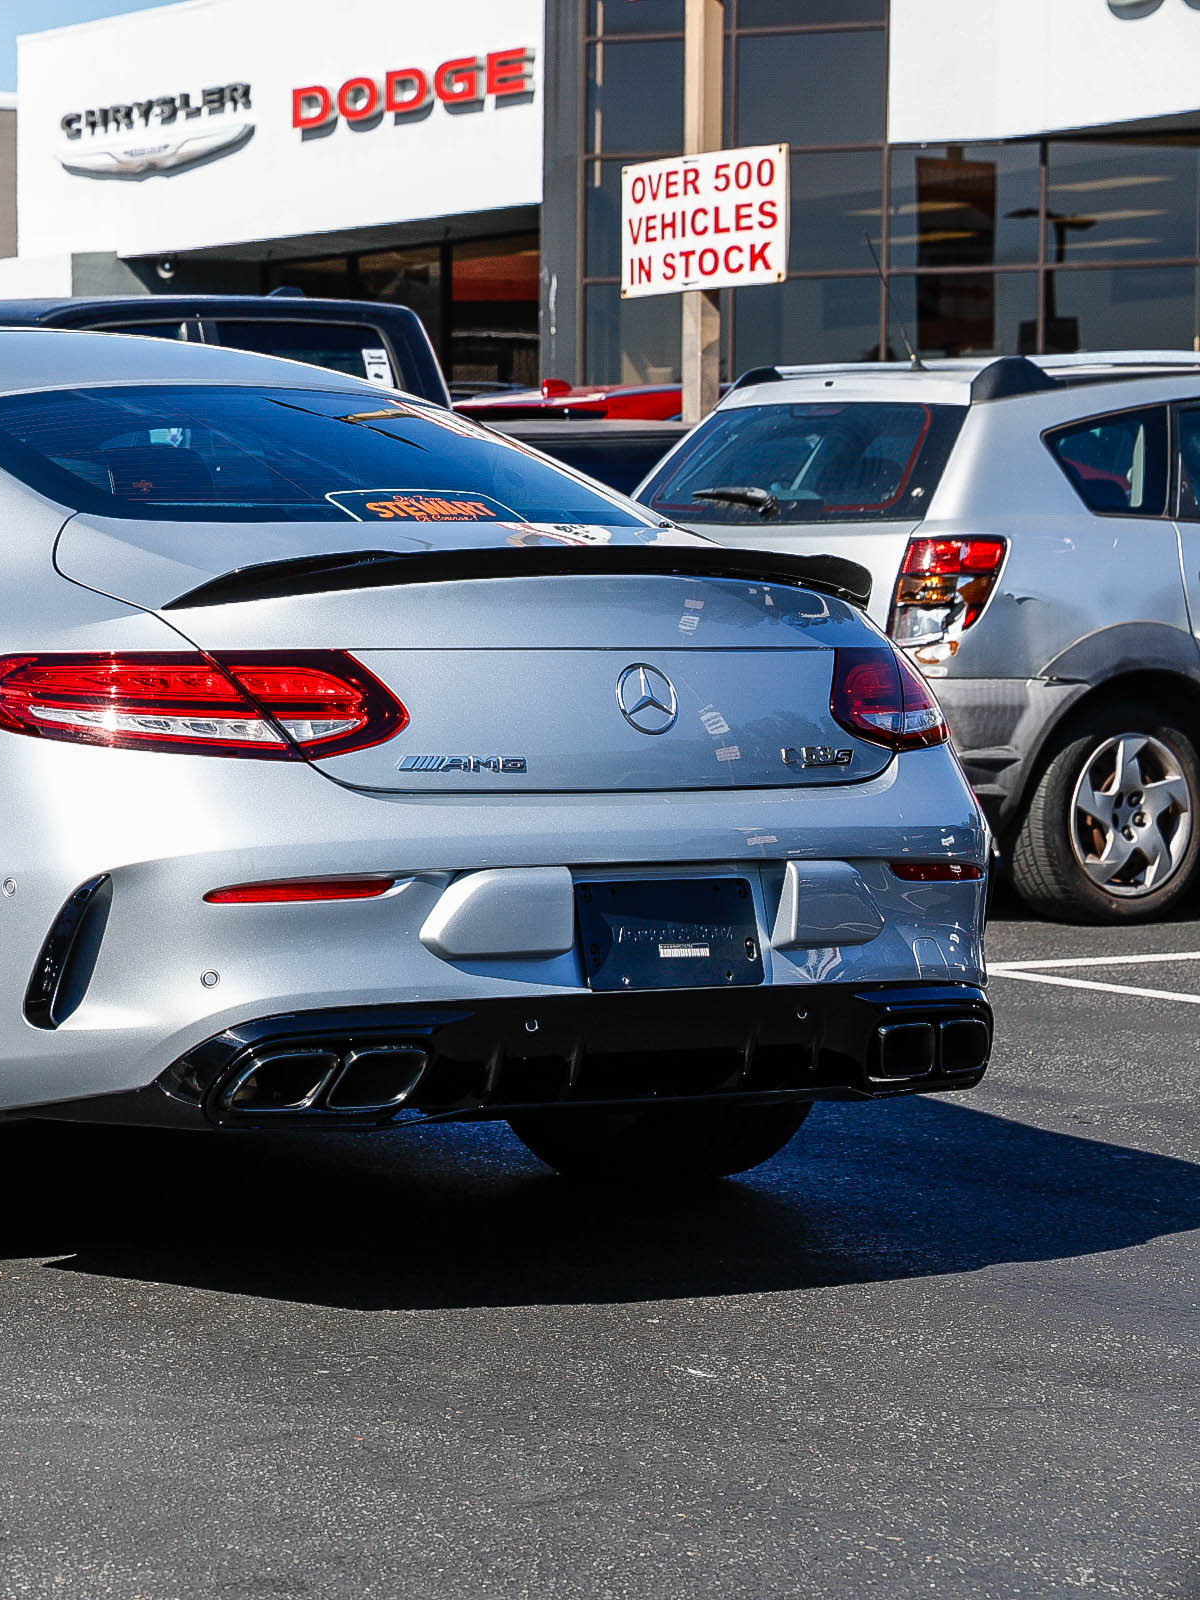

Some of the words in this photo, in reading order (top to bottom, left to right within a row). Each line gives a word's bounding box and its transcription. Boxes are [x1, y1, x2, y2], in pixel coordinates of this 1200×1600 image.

[60, 81, 252, 137] CHRYSLER
[293, 47, 530, 128] DODGE
[631, 167, 700, 205] OVER
[713, 158, 775, 192] 500
[628, 200, 778, 245] VEHICLES
[630, 255, 652, 286] IN
[662, 241, 772, 281] STOCK
[365, 500, 497, 518] STEWART
[438, 755, 527, 774] AMG
